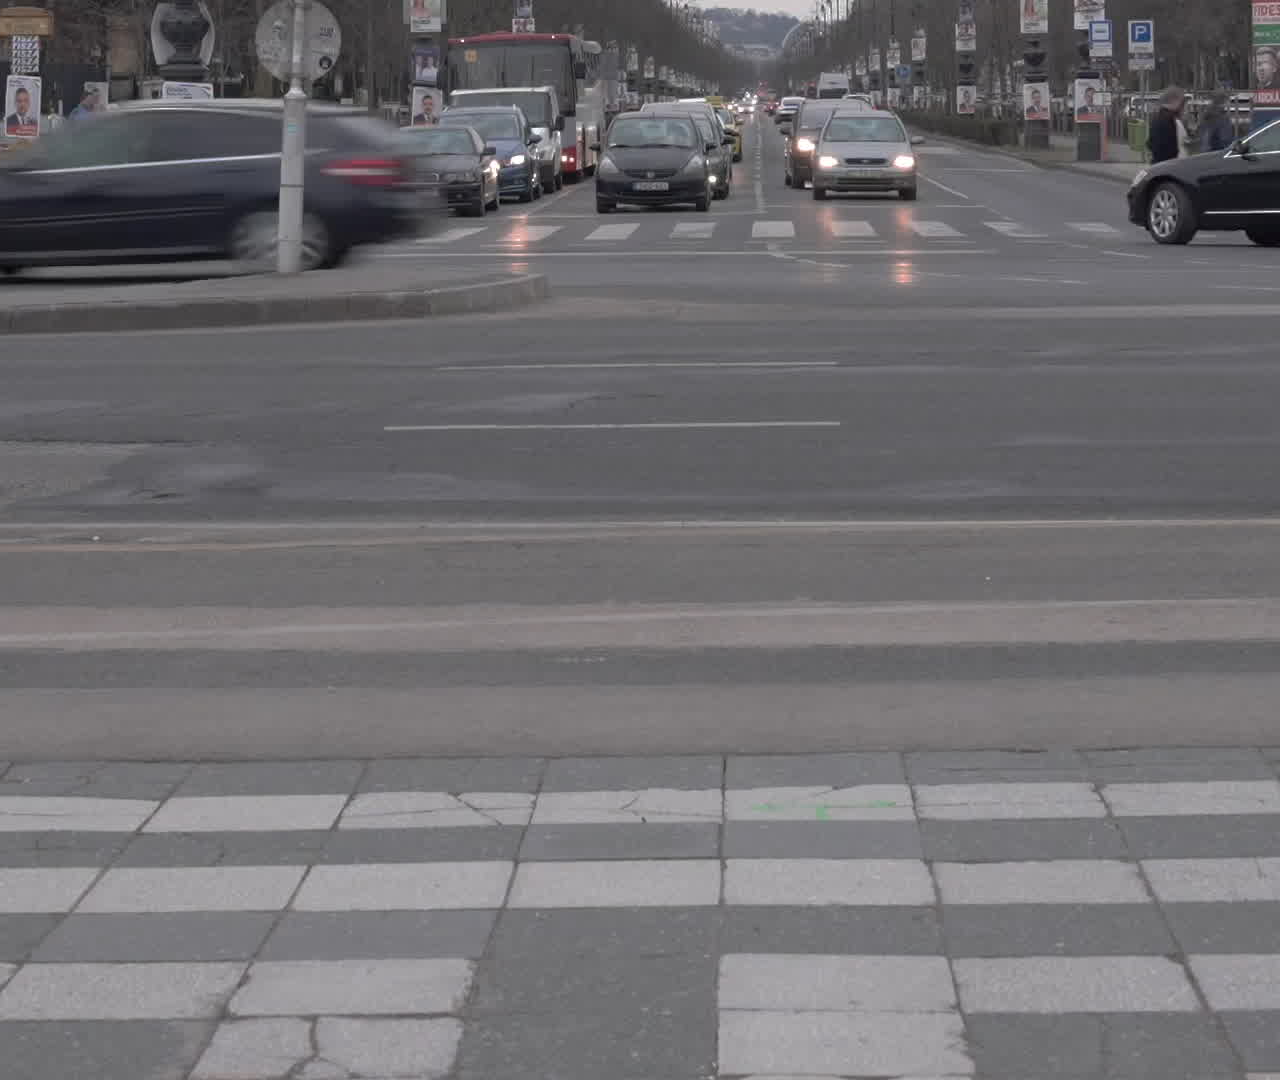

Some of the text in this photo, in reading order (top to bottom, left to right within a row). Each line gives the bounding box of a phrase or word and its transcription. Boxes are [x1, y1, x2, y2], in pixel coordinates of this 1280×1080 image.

[1135, 25, 1147, 41] P
[12, 42, 40, 50] TISZA
[12, 49, 40, 57] TISZA
